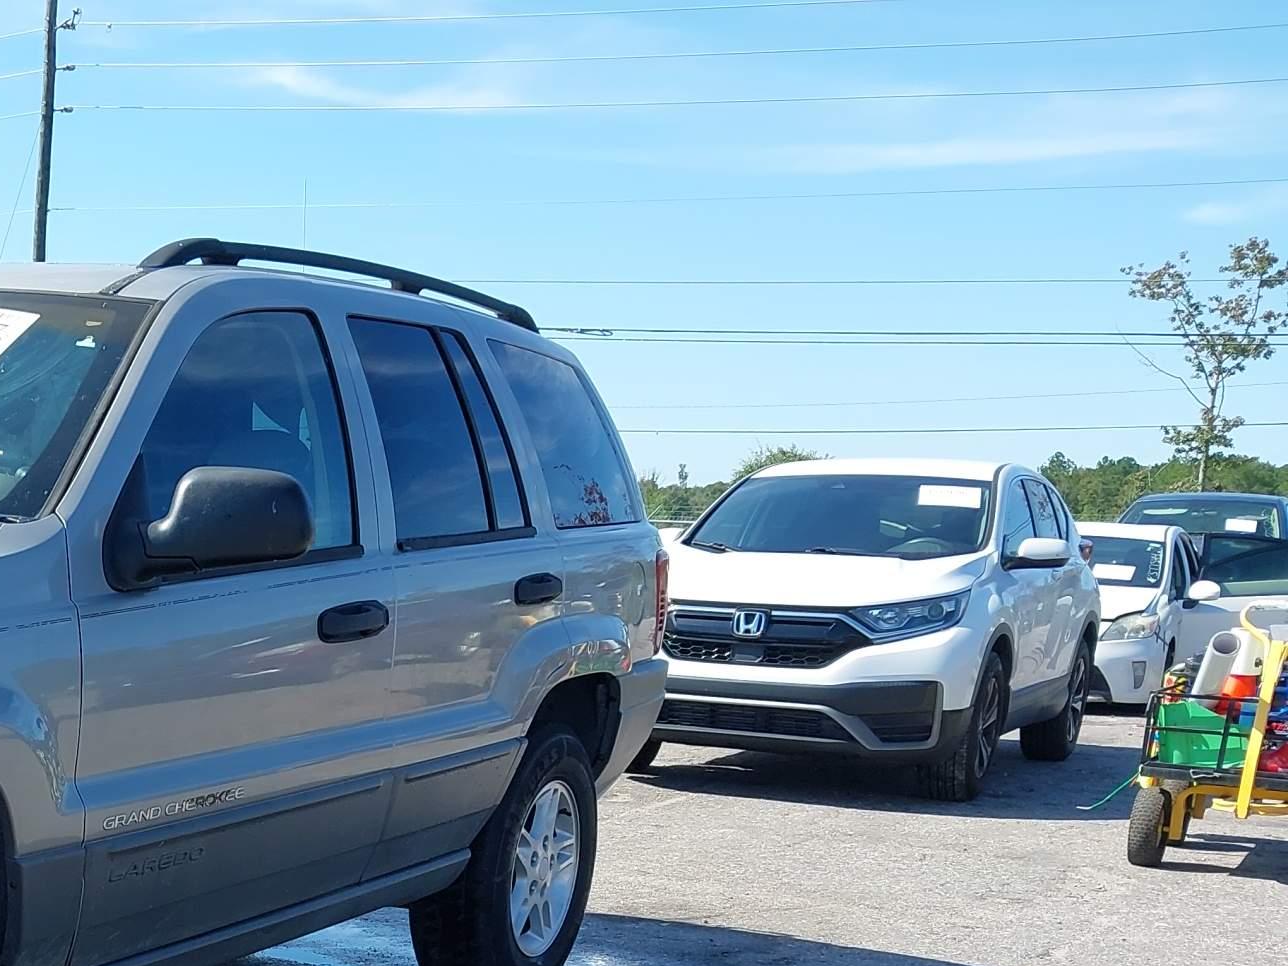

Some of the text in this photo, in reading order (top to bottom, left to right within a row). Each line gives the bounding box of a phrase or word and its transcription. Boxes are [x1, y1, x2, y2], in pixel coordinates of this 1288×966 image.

[103, 786, 246, 831] GRAND CHEROKEE
[107, 847, 205, 884] LAREDO
